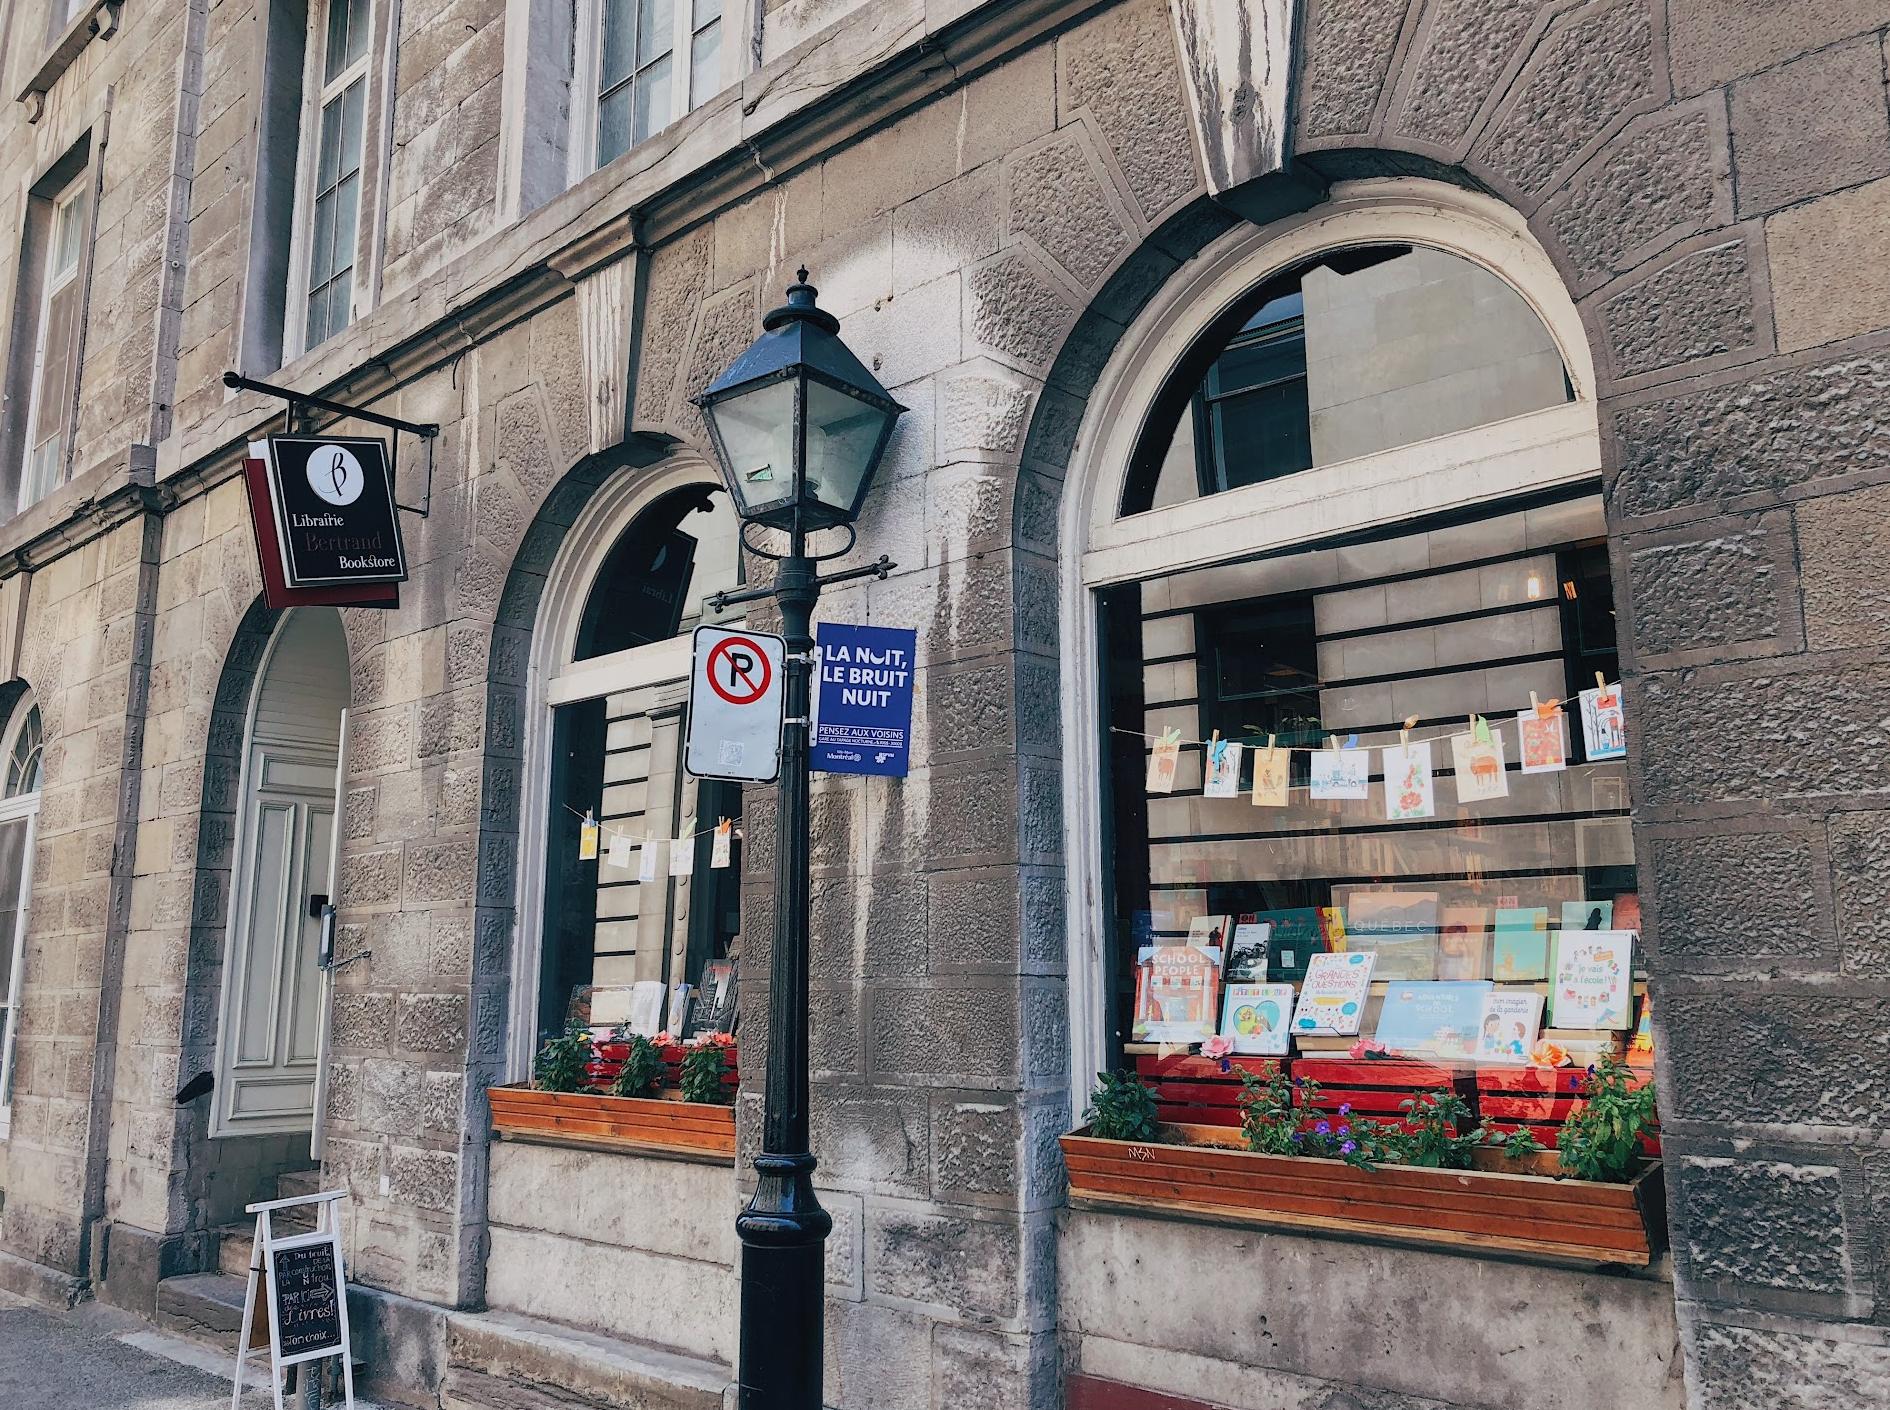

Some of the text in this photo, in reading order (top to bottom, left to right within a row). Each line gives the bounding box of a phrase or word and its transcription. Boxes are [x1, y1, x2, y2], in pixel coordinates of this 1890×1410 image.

[292, 512, 345, 527] Librairie
[305, 530, 382, 552] Bertrand
[339, 554, 396, 569] Bookstore
[826, 645, 908, 669] LA NUIT,
[730, 652, 754, 687] P
[822, 665, 909, 688] LE BRUIT
[842, 688, 892, 708] NUIT
[819, 726, 904, 740] PENSEZ AUX VOISINS
[826, 752, 853, 761] Montréal
[1152, 954, 1206, 965] SCHOOL
[1155, 965, 1199, 976] PEOPLE
[1312, 979, 1357, 989] QUESTIONS
